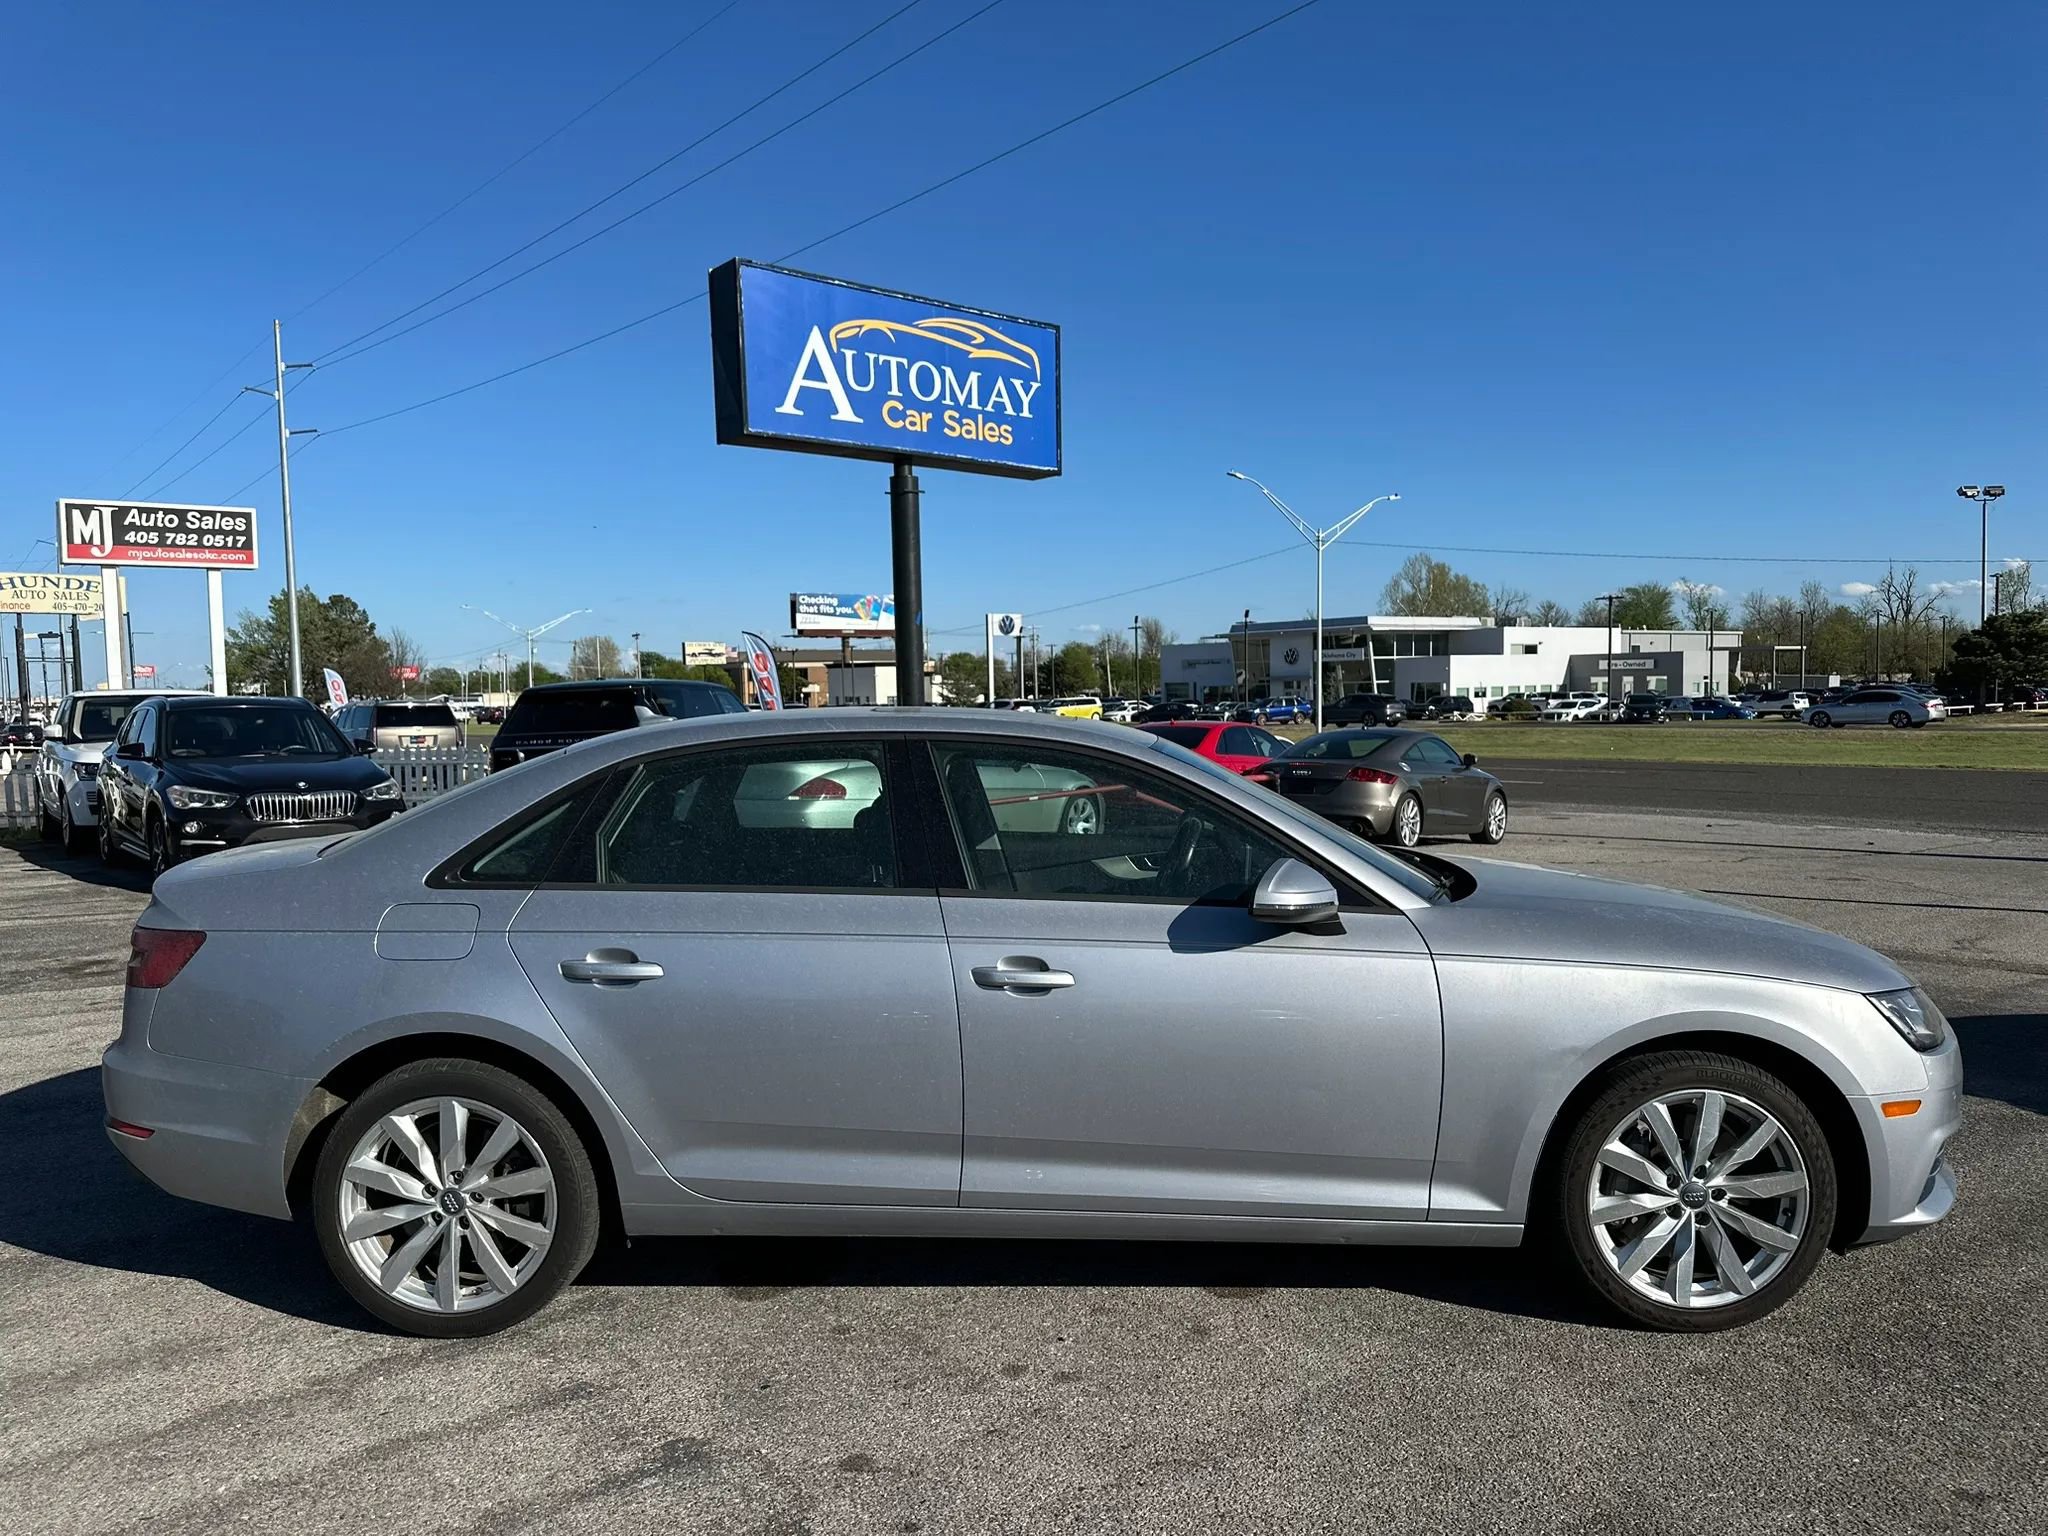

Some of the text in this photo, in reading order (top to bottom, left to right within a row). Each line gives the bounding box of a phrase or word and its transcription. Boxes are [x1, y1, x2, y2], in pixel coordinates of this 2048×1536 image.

[775, 325, 1041, 423] AUTOMAY
[881, 400, 1013, 446] Car Sales
[123, 508, 247, 532] Auto Sales
[71, 506, 119, 558] MJ
[125, 531, 247, 548] 405 782 0517
[127, 548, 247, 561] mjautosalesokc.com
[0, 575, 102, 593] HUNDE
[11, 589, 90, 601] AUTO SALES
[799, 595, 838, 606] Checking
[799, 604, 855, 616] that fits you.
